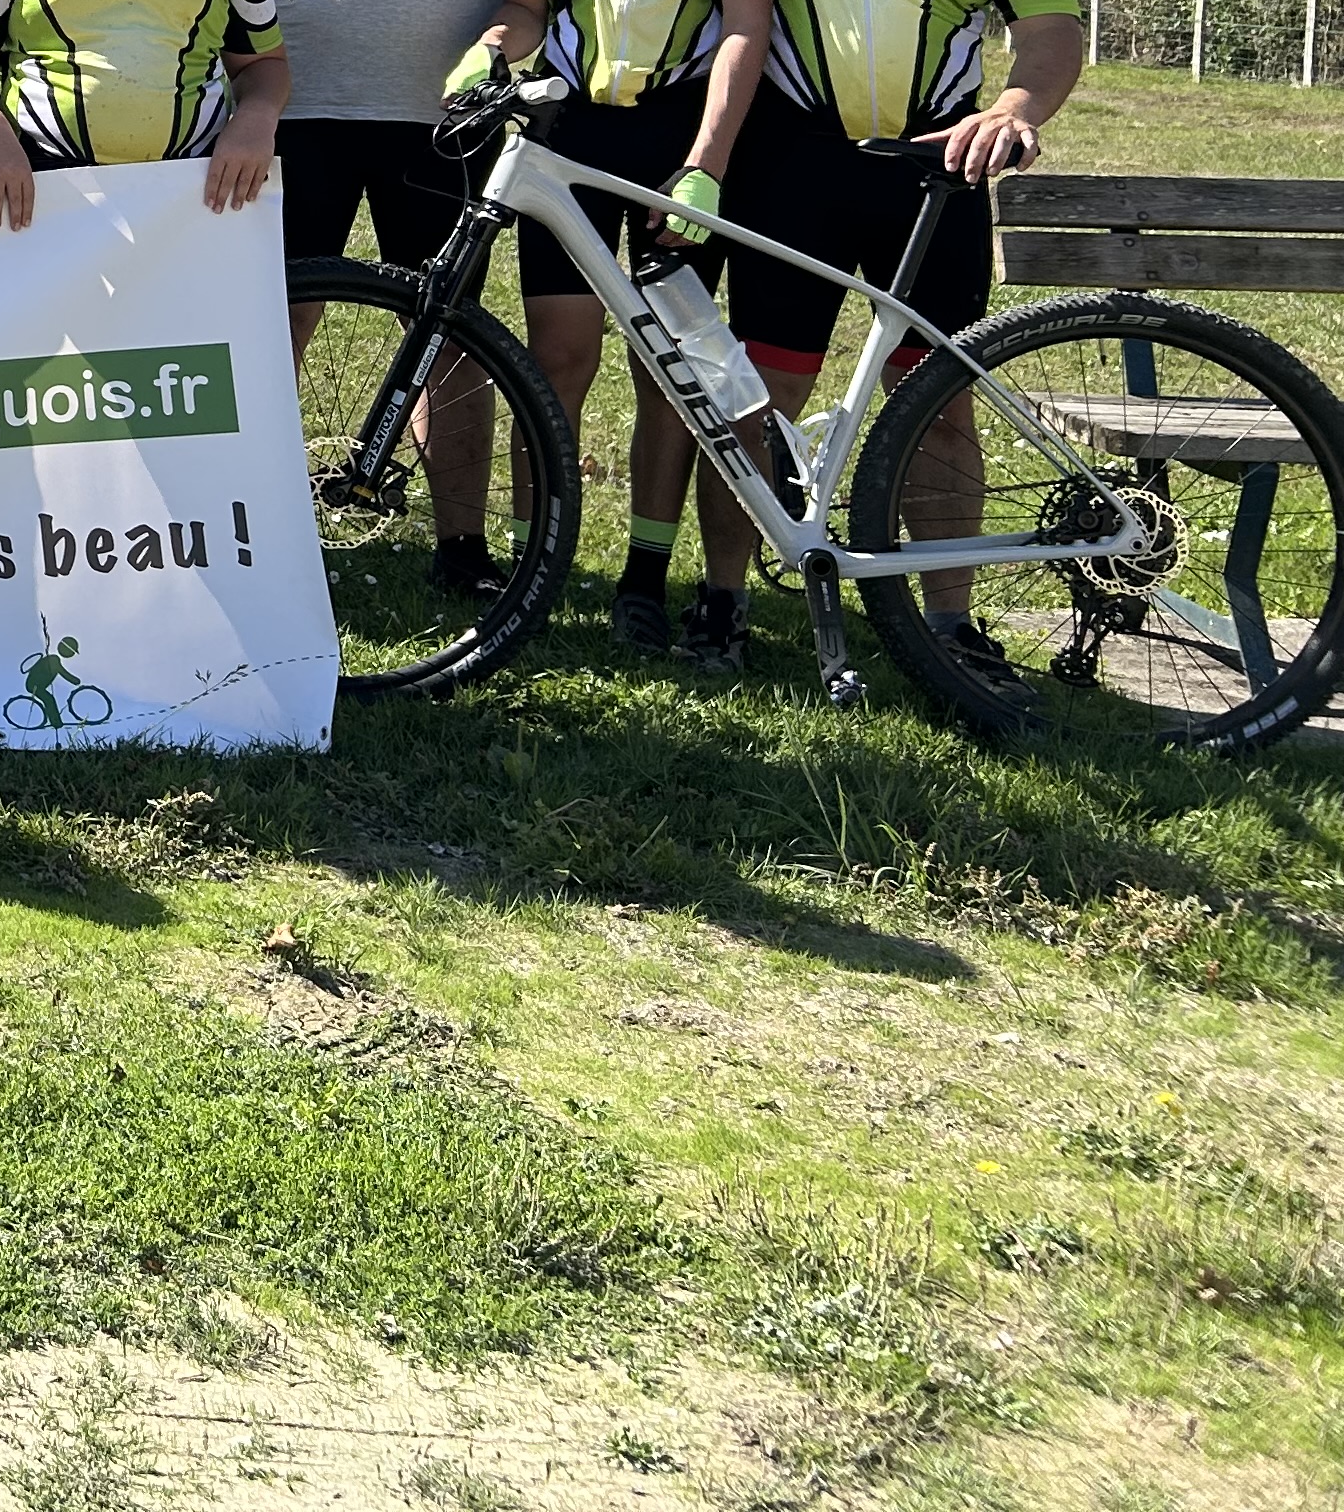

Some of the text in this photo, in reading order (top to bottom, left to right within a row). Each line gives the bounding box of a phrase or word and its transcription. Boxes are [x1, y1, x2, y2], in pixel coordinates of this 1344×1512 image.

[982, 314, 1168, 360] SCHWALBE
[630, 312, 759, 480] CUBE
[372, 405, 398, 455] SUNTOUR
[37, 512, 210, 578] beau
[231, 501, 253, 567] !
[522, 557, 549, 611] RAY
